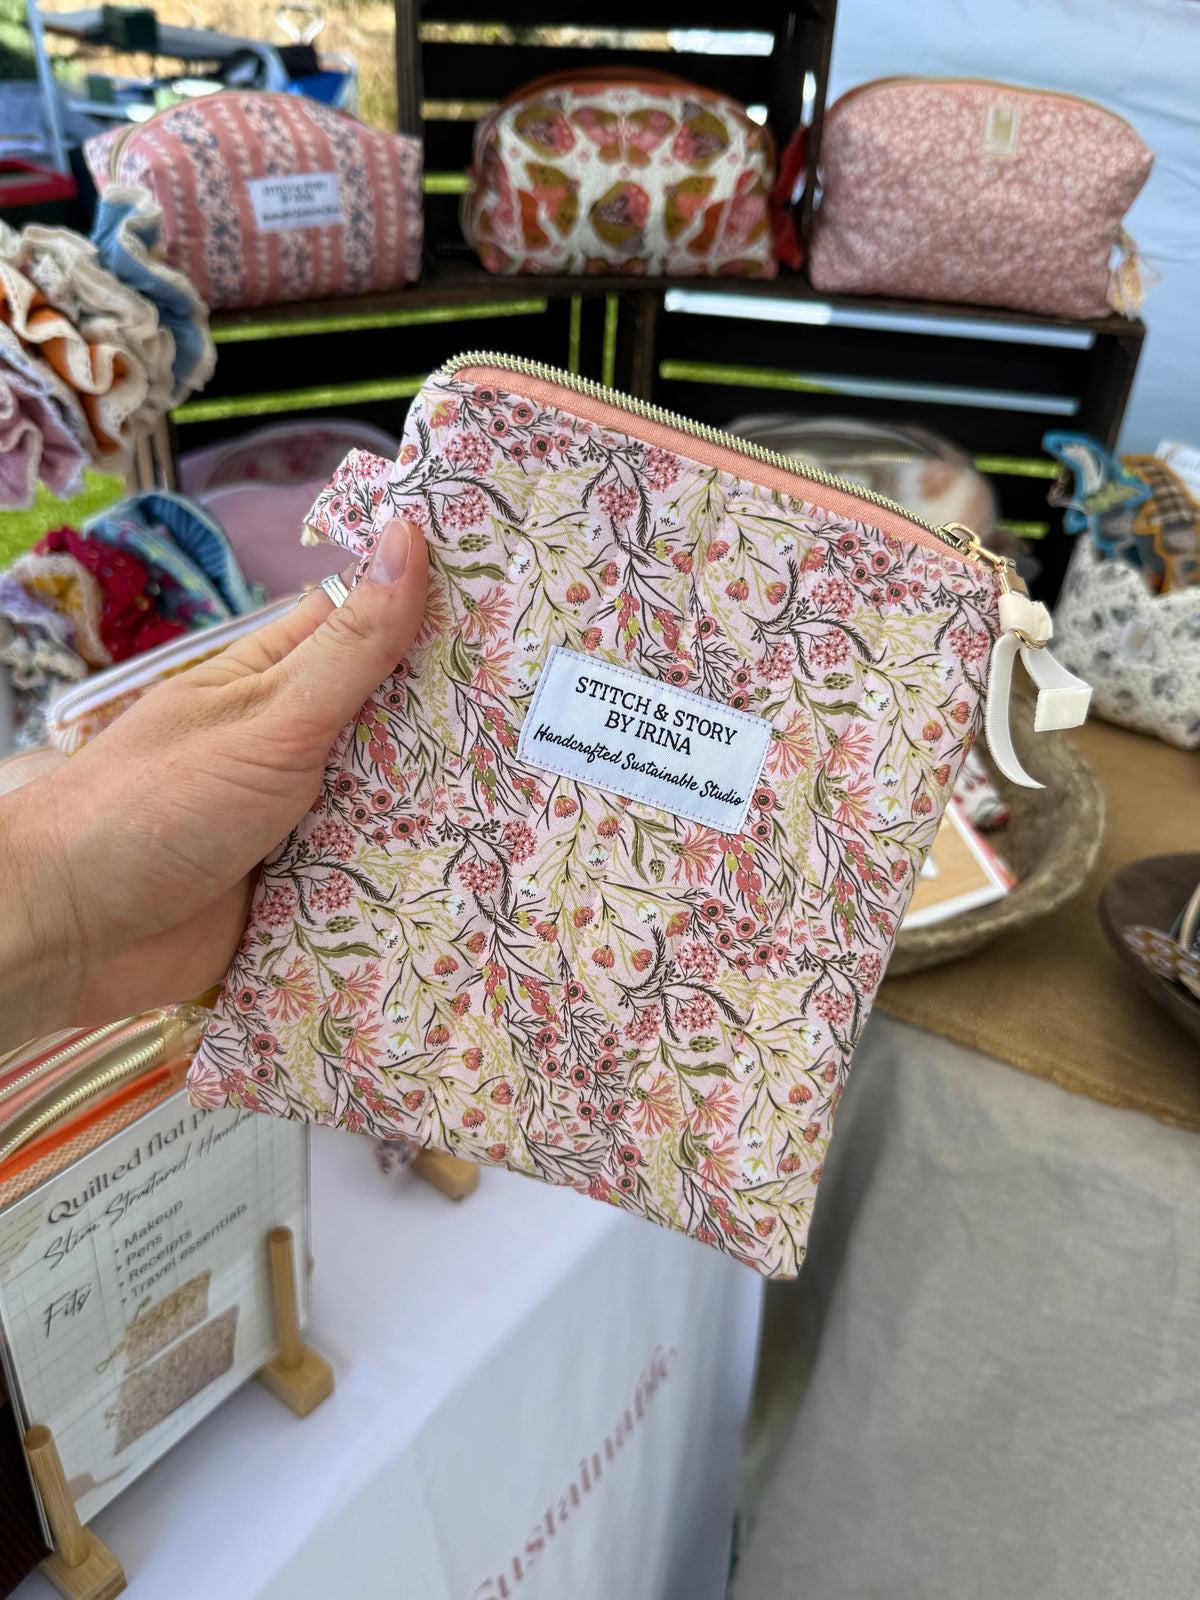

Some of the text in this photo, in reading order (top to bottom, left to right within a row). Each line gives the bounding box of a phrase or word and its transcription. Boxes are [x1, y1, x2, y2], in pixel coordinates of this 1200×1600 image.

[575, 676, 738, 746] STITCH & STORY
[604, 710, 692, 756] BY IRINA
[533, 723, 745, 807] Handcrafted Sustainable Studio
[48, 1147, 142, 1225] Quilted
[148, 1117, 186, 1158] flat
[124, 1199, 184, 1250] Makeup
[126, 1233, 164, 1266] Pens
[128, 1227, 193, 1281] Receipts
[130, 1201, 249, 1297] Travel essentials
